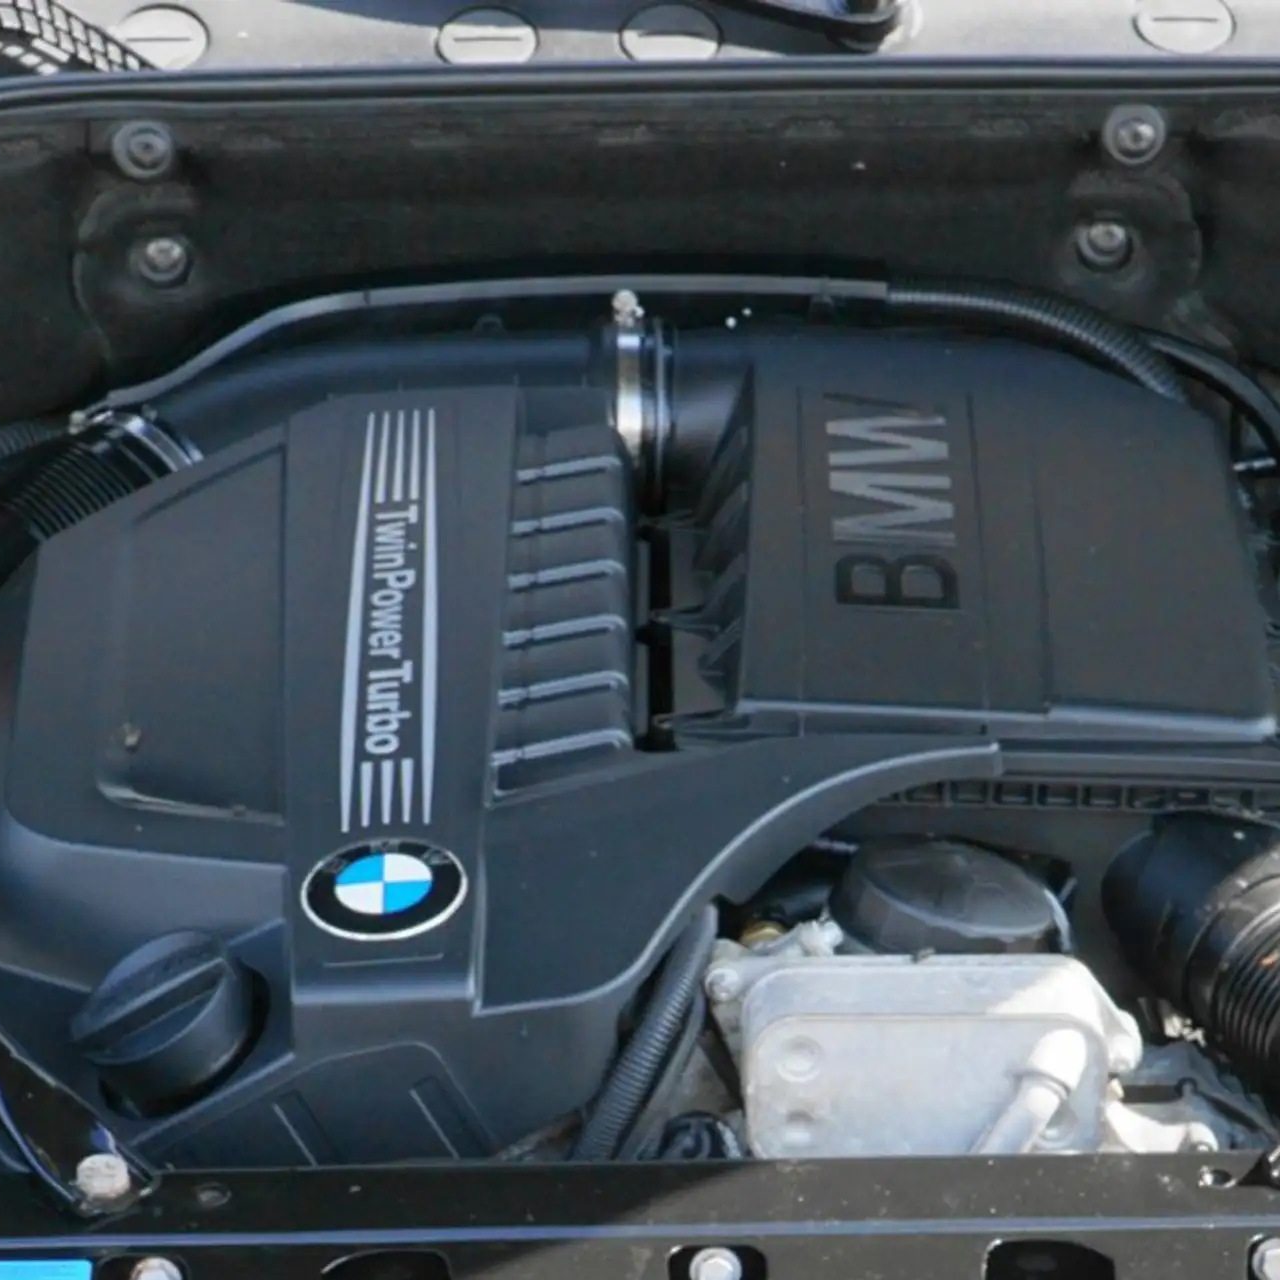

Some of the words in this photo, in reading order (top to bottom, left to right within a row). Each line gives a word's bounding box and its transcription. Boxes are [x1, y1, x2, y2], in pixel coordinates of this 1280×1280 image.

[823, 392, 960, 609] BMW
[368, 504, 419, 659] TwinPower
[364, 661, 413, 755] Turbo
